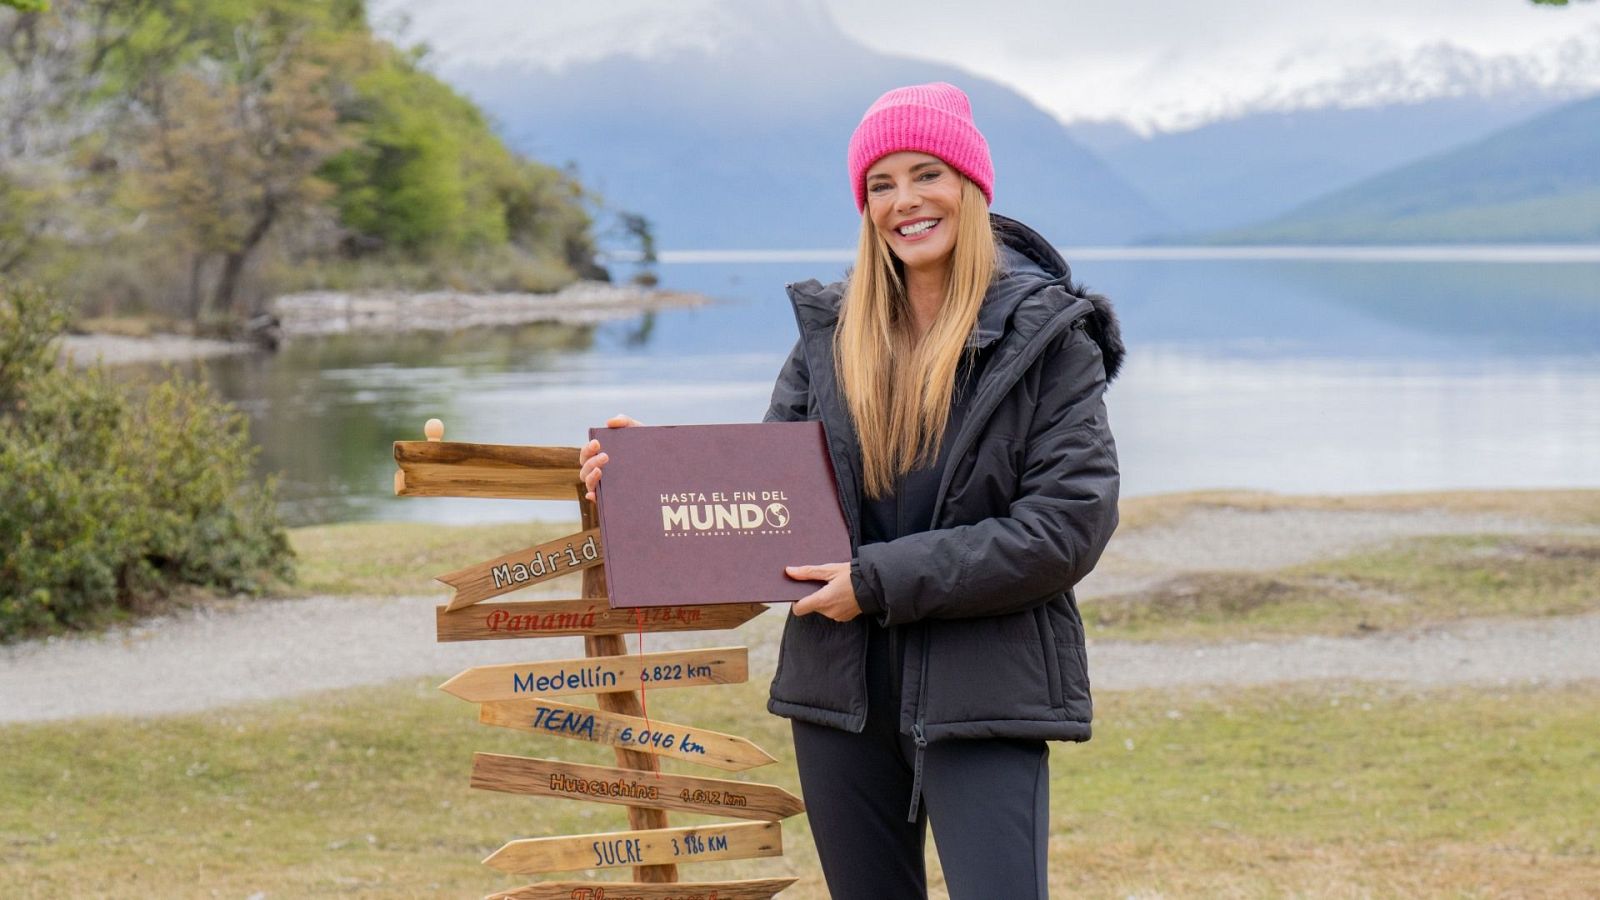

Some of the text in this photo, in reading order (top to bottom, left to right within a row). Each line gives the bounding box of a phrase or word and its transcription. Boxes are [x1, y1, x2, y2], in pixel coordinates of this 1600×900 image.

[660, 491, 788, 503] HASTA EL FIN DEL
[491, 535, 598, 589] Madrid
[486, 605, 596, 632] Panamá
[676, 607, 701, 624] km
[513, 663, 712, 693] Medellín 6.822 km
[533, 706, 705, 754] TENA 6.046 km
[550, 773, 747, 807] Huacachina 4.612 km
[593, 833, 728, 867] SUCRE 3.986 KM
